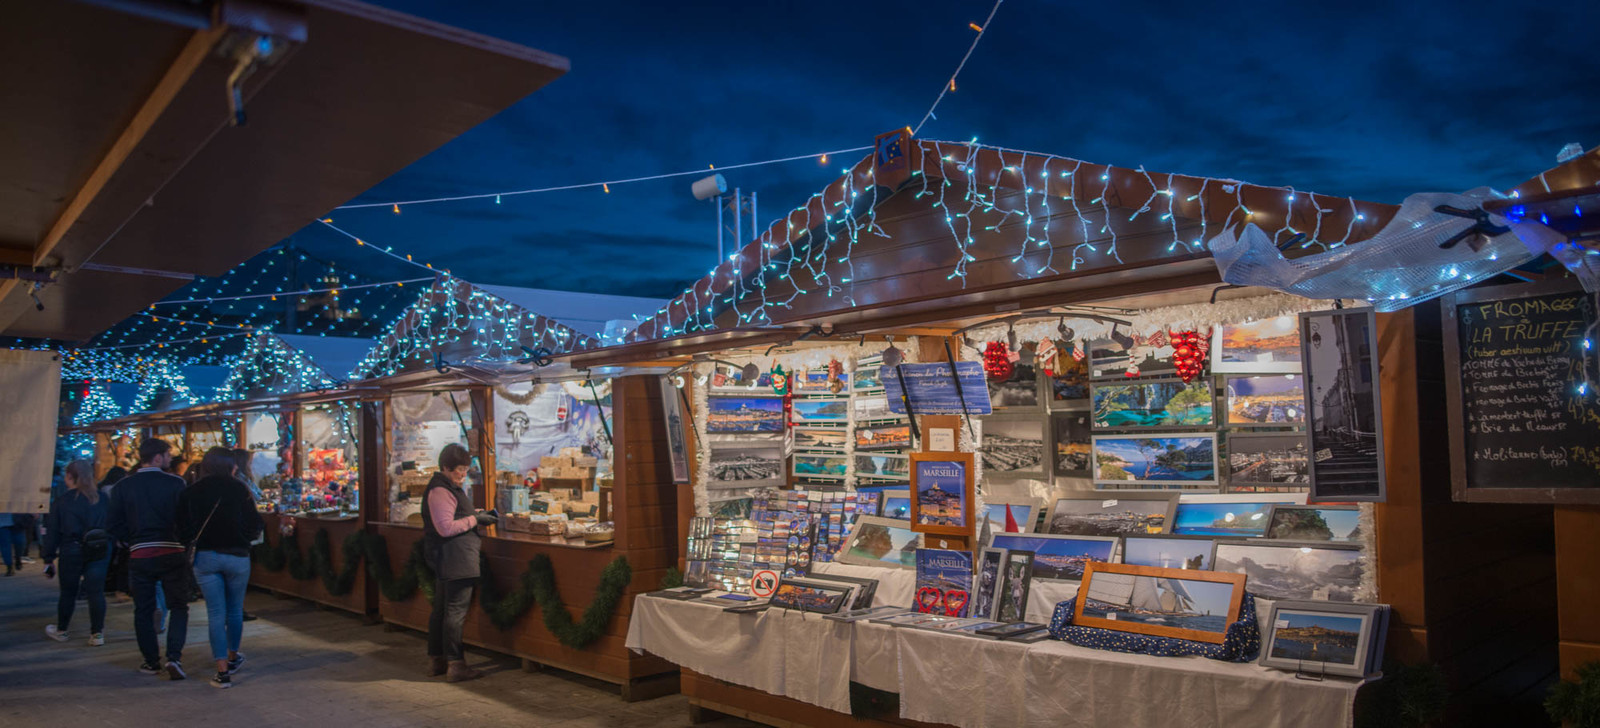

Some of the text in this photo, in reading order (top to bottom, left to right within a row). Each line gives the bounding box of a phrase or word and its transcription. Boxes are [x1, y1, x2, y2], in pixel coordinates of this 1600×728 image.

[1472, 320, 1584, 344] LA TRUFFE
[1480, 421, 1504, 433] Brie
[923, 469, 959, 477] MARSEILLE
[928, 557, 965, 568] MARSEILLE
